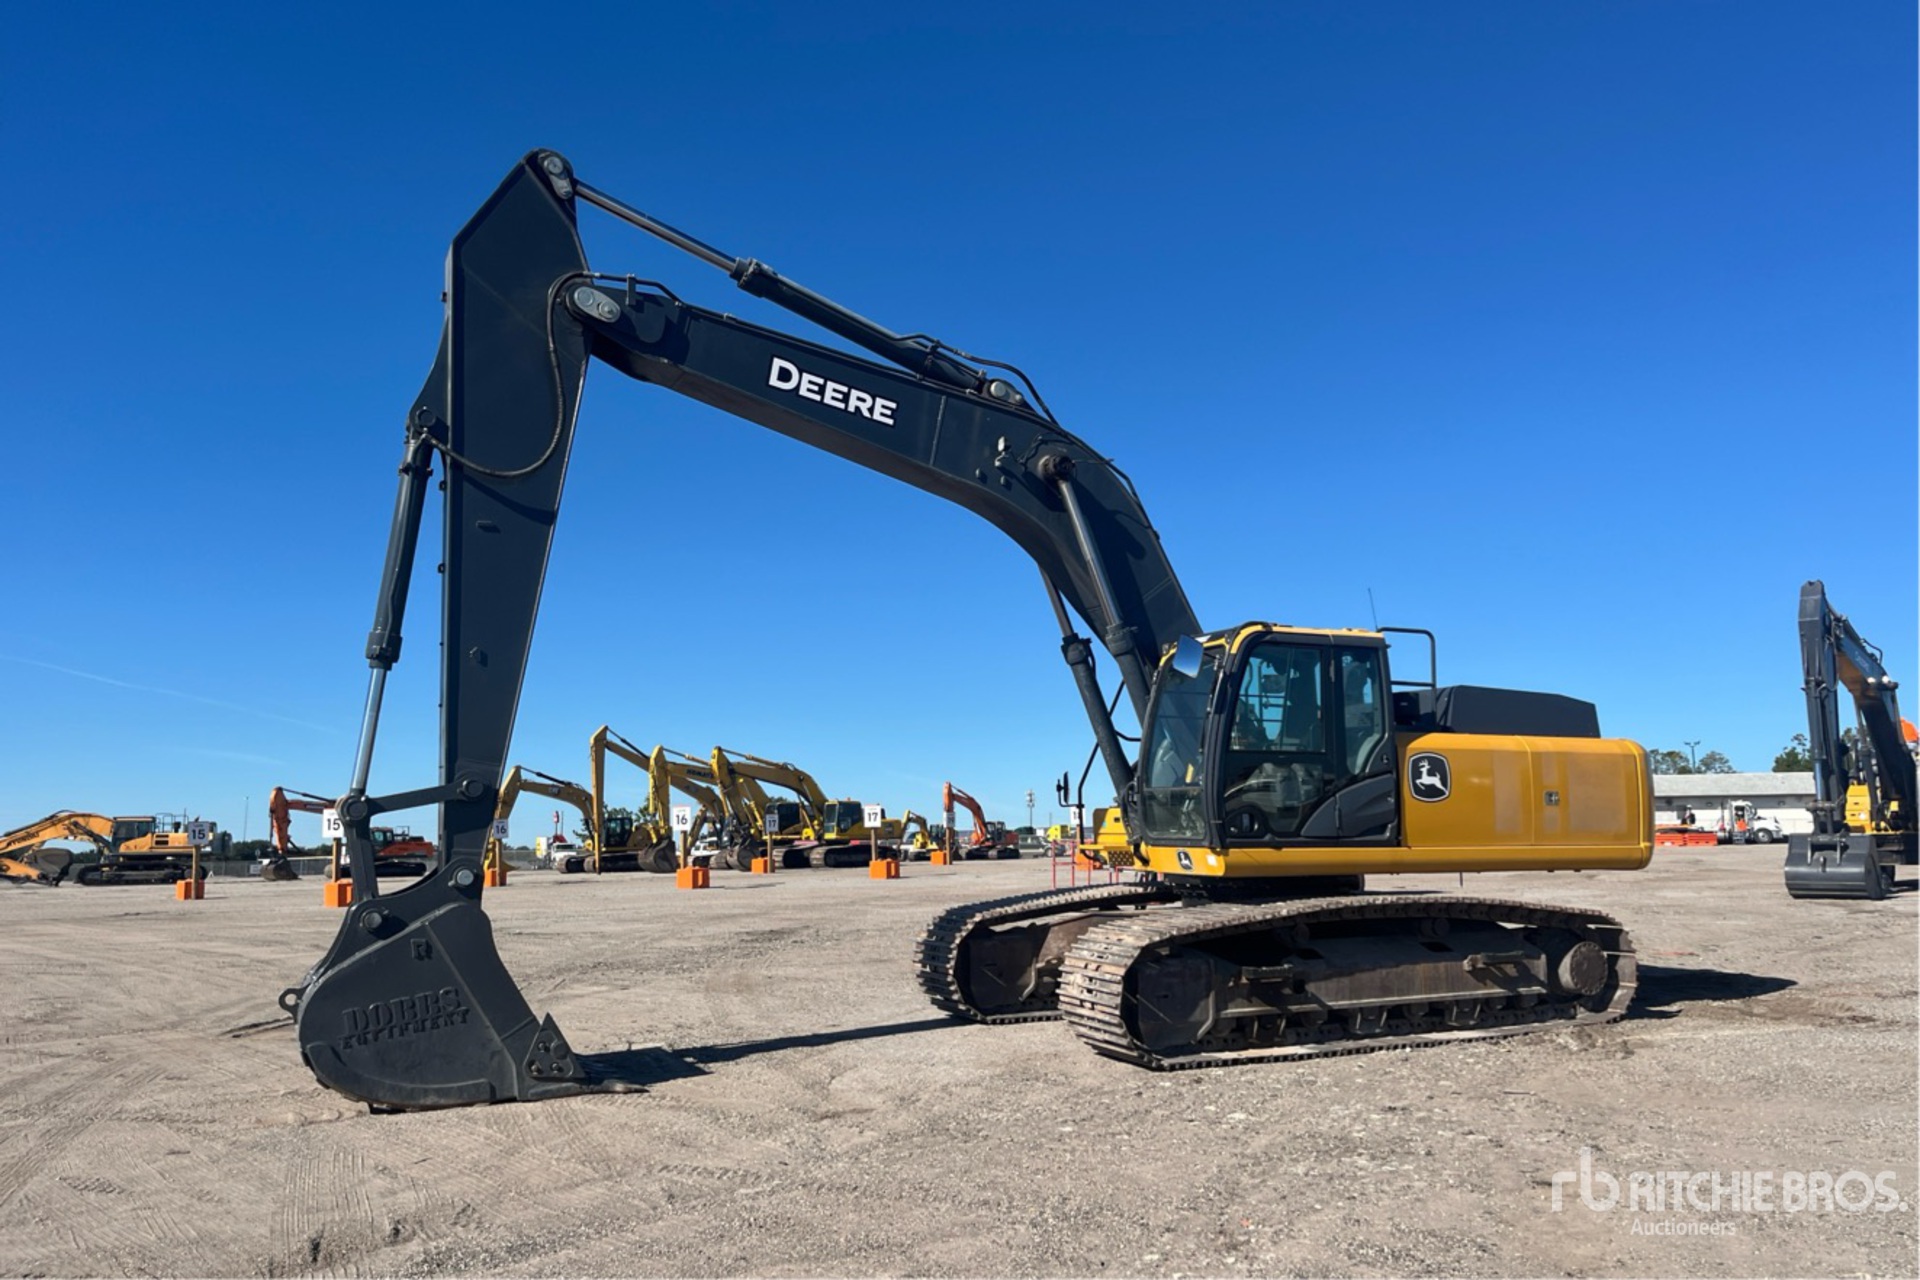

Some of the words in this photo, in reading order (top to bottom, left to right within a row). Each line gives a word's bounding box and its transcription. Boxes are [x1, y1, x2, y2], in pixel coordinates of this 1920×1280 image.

[768, 357, 898, 426] DEERE
[675, 813, 688, 826] 16
[767, 818, 778, 829] 17
[867, 812, 879, 823] 17
[326, 817, 341, 831] 15
[495, 824, 507, 834] 16
[192, 828, 206, 840] 15
[342, 986, 462, 1033] DOBBS
